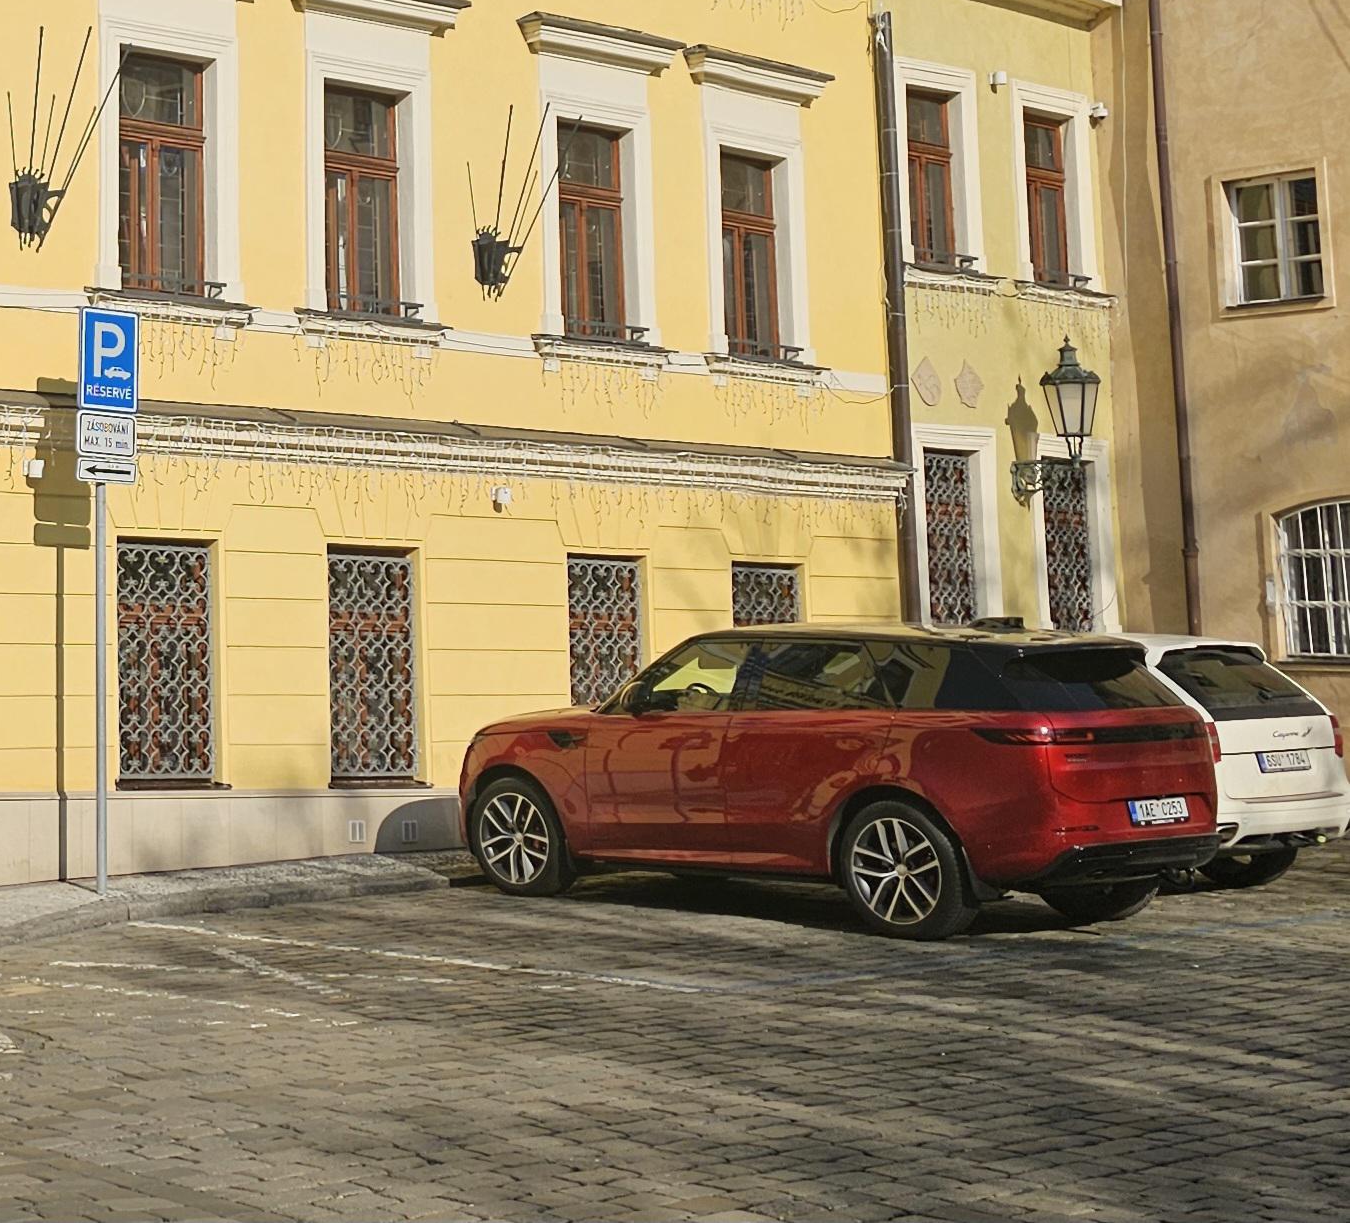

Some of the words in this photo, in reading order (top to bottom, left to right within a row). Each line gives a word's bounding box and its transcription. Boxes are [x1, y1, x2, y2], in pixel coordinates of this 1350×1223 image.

[93, 321, 126, 377] P
[86, 383, 132, 400] RÉSERVÉ
[86, 419, 130, 435] ZÁSOBOVÁNÍ
[105, 437, 113, 448] 15
[1139, 802, 1157, 818] 1AE
[1161, 800, 1184, 816] C253
